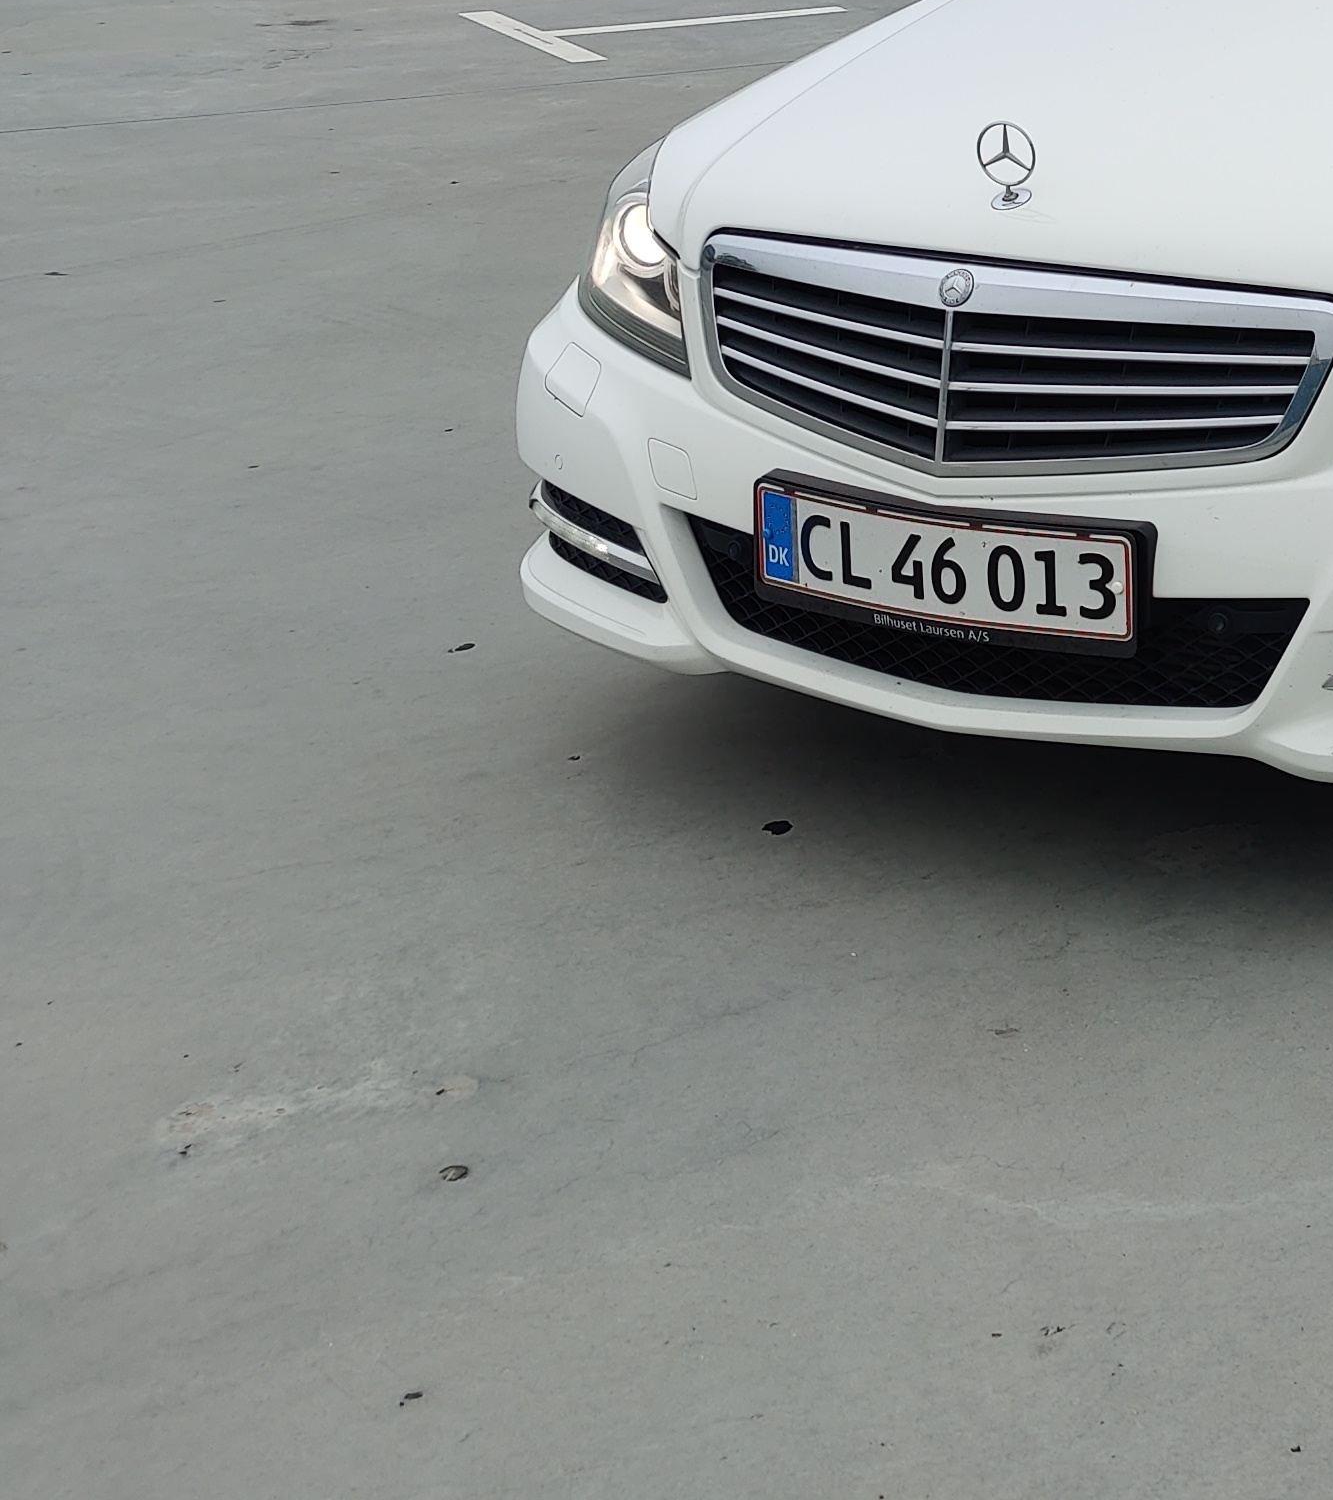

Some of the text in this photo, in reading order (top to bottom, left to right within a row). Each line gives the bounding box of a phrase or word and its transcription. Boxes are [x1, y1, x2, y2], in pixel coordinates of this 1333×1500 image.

[768, 544, 789, 567] DK
[800, 514, 1116, 620] CL 46 013
[873, 613, 990, 643] Bilhuset Laursen A/S
